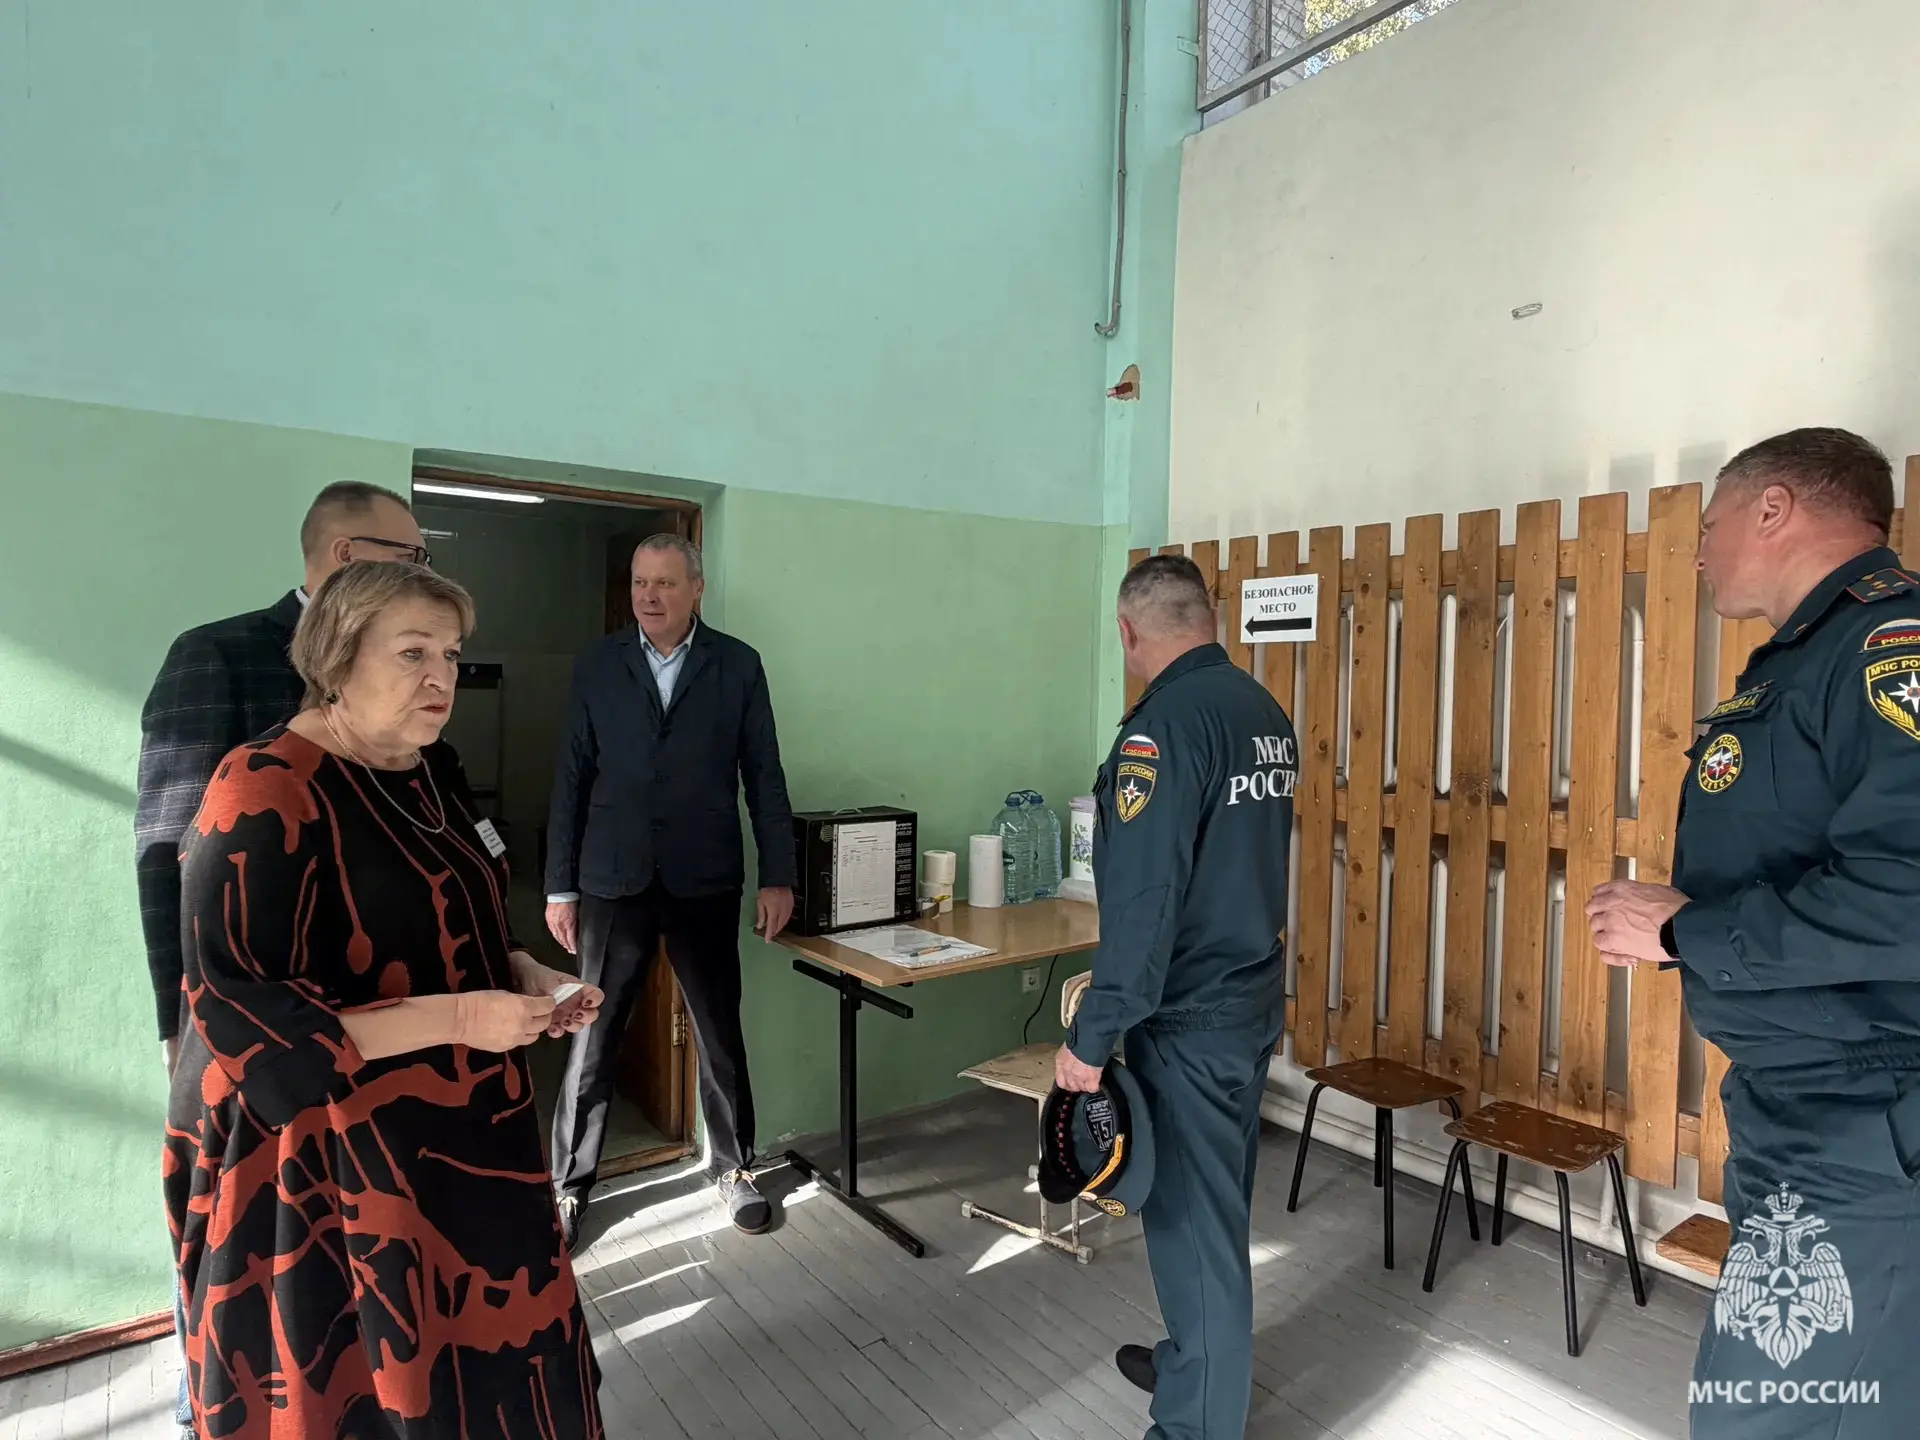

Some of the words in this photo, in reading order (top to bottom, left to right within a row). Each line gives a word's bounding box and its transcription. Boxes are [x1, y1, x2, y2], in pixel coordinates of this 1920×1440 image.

[1244, 584, 1314, 600] БЕЗОПАСНОЕ
[1259, 602, 1297, 614] МЕСТО
[1870, 662, 1898, 677] МЧС
[1901, 659, 1920, 669] РО
[1252, 736, 1295, 766] МЧС
